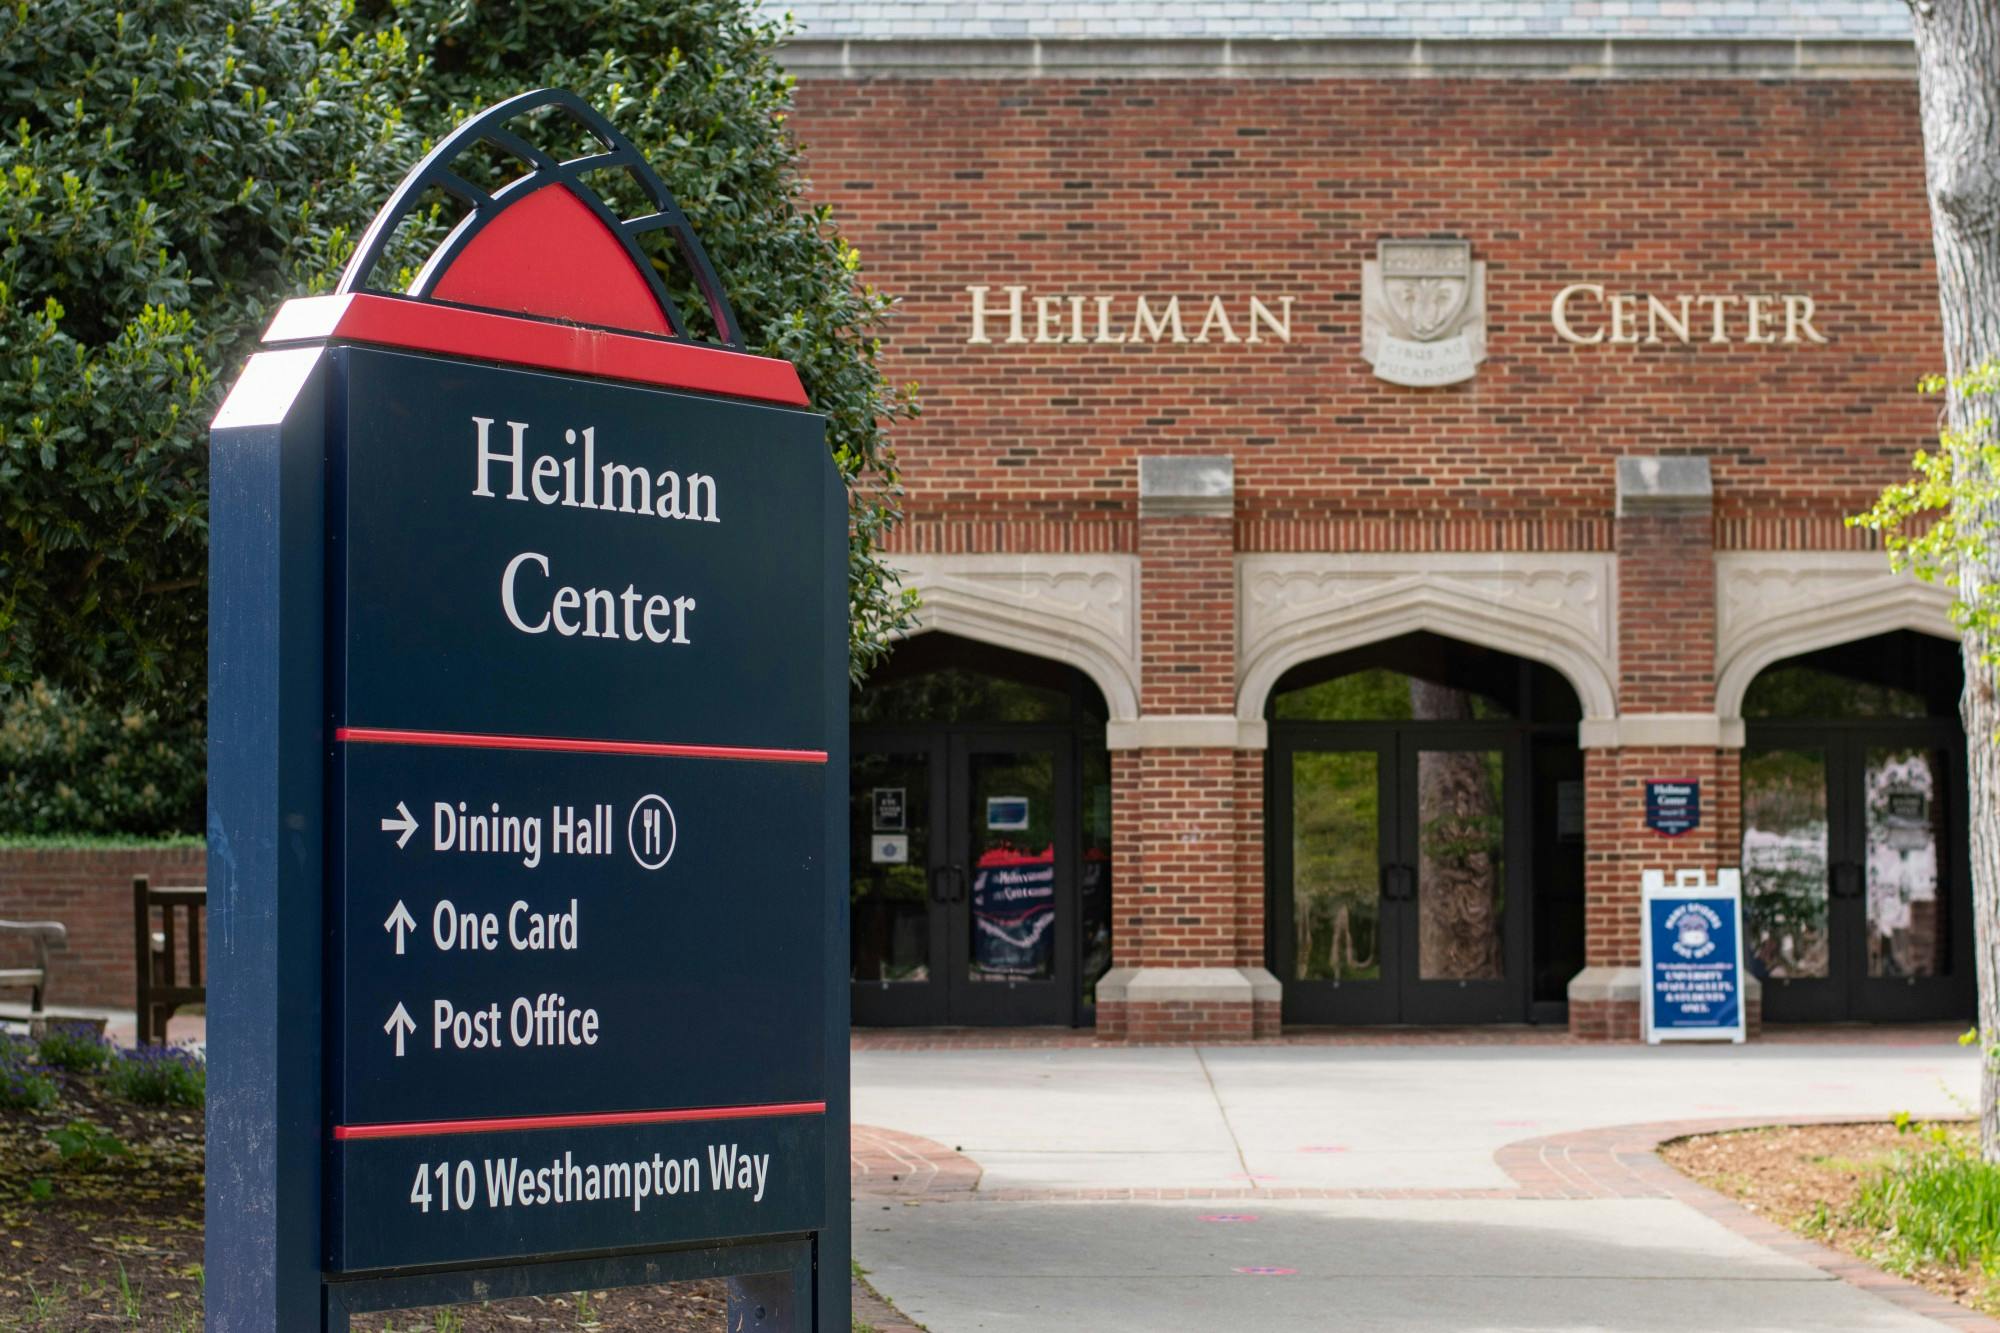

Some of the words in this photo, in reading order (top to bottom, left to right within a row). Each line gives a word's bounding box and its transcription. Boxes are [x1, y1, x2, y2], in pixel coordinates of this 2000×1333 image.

[965, 285, 1296, 344] HEILMAN
[1551, 283, 1829, 344] CENTER
[472, 416, 721, 523] Heilman
[501, 552, 696, 645] Center
[434, 801, 542, 869] Dining
[552, 804, 613, 855] Hall
[433, 899, 499, 951] One
[508, 898, 578, 951] Card
[434, 999, 502, 1049] Post
[510, 992, 599, 1047] Office
[410, 1159, 476, 1213] 410
[484, 1151, 700, 1212] Westhampton
[707, 1143, 770, 1203] Way
